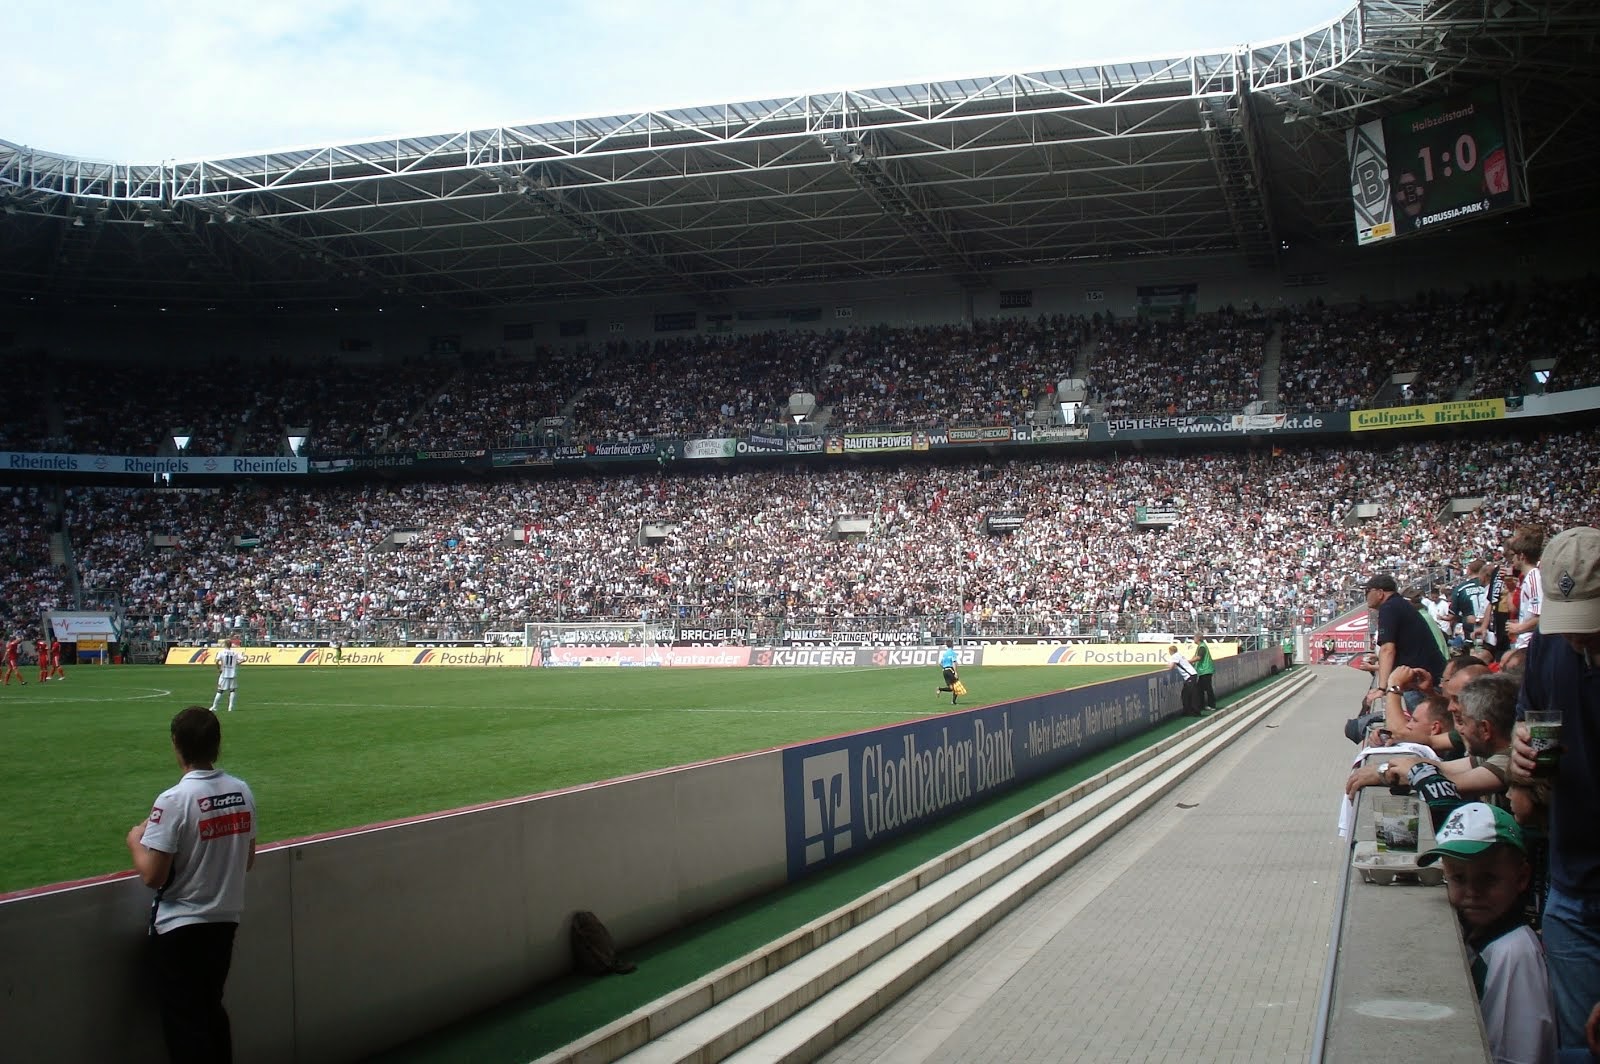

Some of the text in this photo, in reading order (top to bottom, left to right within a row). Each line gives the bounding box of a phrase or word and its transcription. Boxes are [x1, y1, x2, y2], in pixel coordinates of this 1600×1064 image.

[1412, 104, 1474, 133] Halbzeitstand
[1418, 134, 1477, 182] 1:0
[1422, 202, 1483, 226] BORUSSIA-PARK
[1358, 407, 1496, 425] Golfpark Birkhof
[594, 443, 641, 455] Heartbreakers
[844, 435, 912, 449] RAUTEN-POWER
[9, 454, 78, 470] Rheinfels
[124, 458, 189, 472] Rheinfels
[233, 459, 297, 472] Rheinfels
[681, 629, 745, 641] BRACHELEN
[833, 633, 870, 642] RATINGEN
[440, 652, 504, 664] Postbank
[665, 651, 741, 664] Santander
[1085, 649, 1167, 663] Postbank
[861, 727, 973, 840] Gladbacher
[974, 712, 1015, 793] Bank
[1028, 720, 1050, 758] Mehr
[213, 795, 243, 807] lotto
